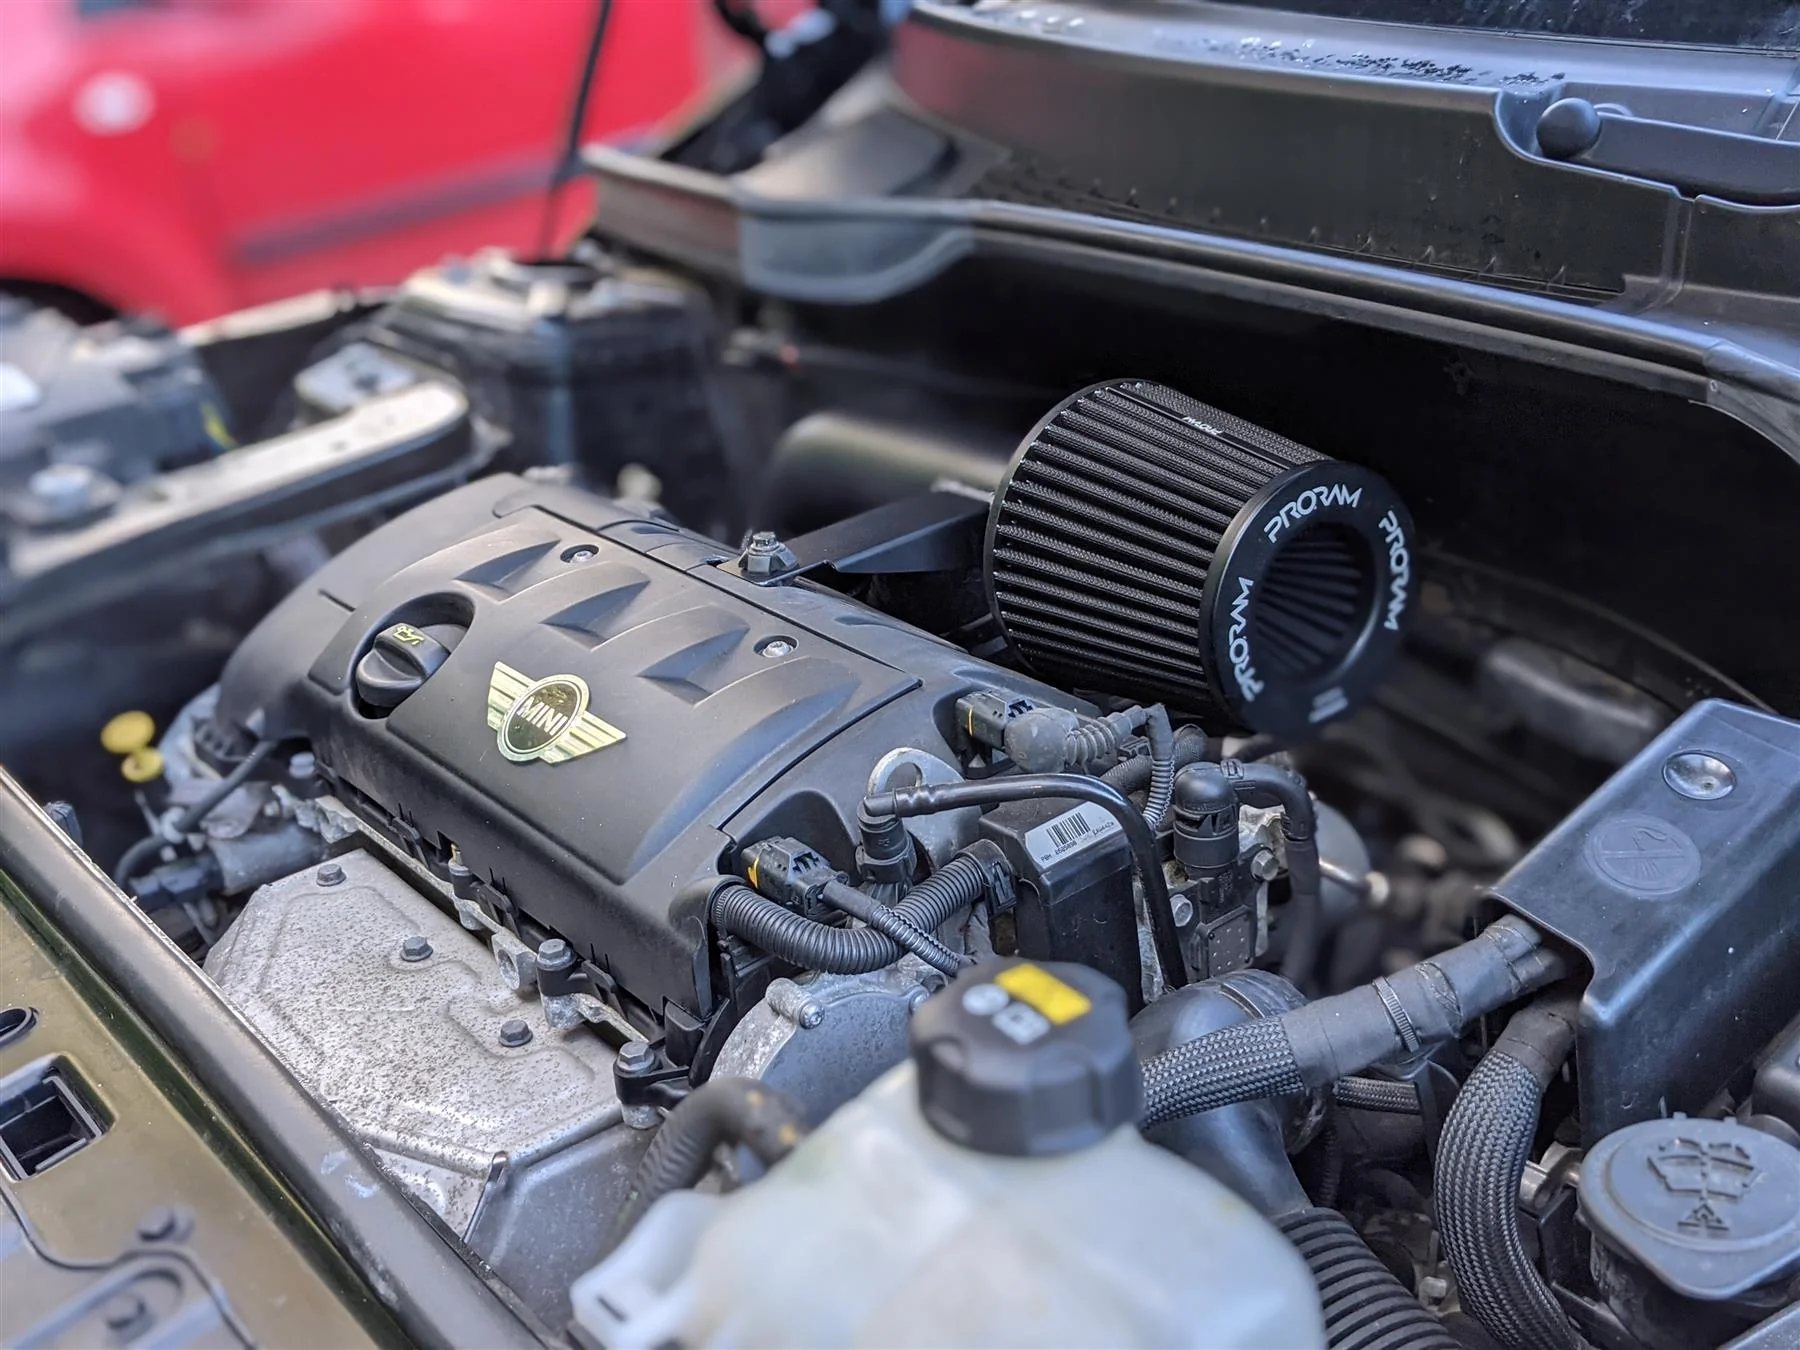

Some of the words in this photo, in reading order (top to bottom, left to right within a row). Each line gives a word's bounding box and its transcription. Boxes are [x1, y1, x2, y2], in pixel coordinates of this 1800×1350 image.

[1263, 484, 1363, 544] PRORAM
[1378, 510, 1409, 631] PRORAM
[1228, 576, 1264, 702] PRORAM
[516, 695, 569, 737] MINI
